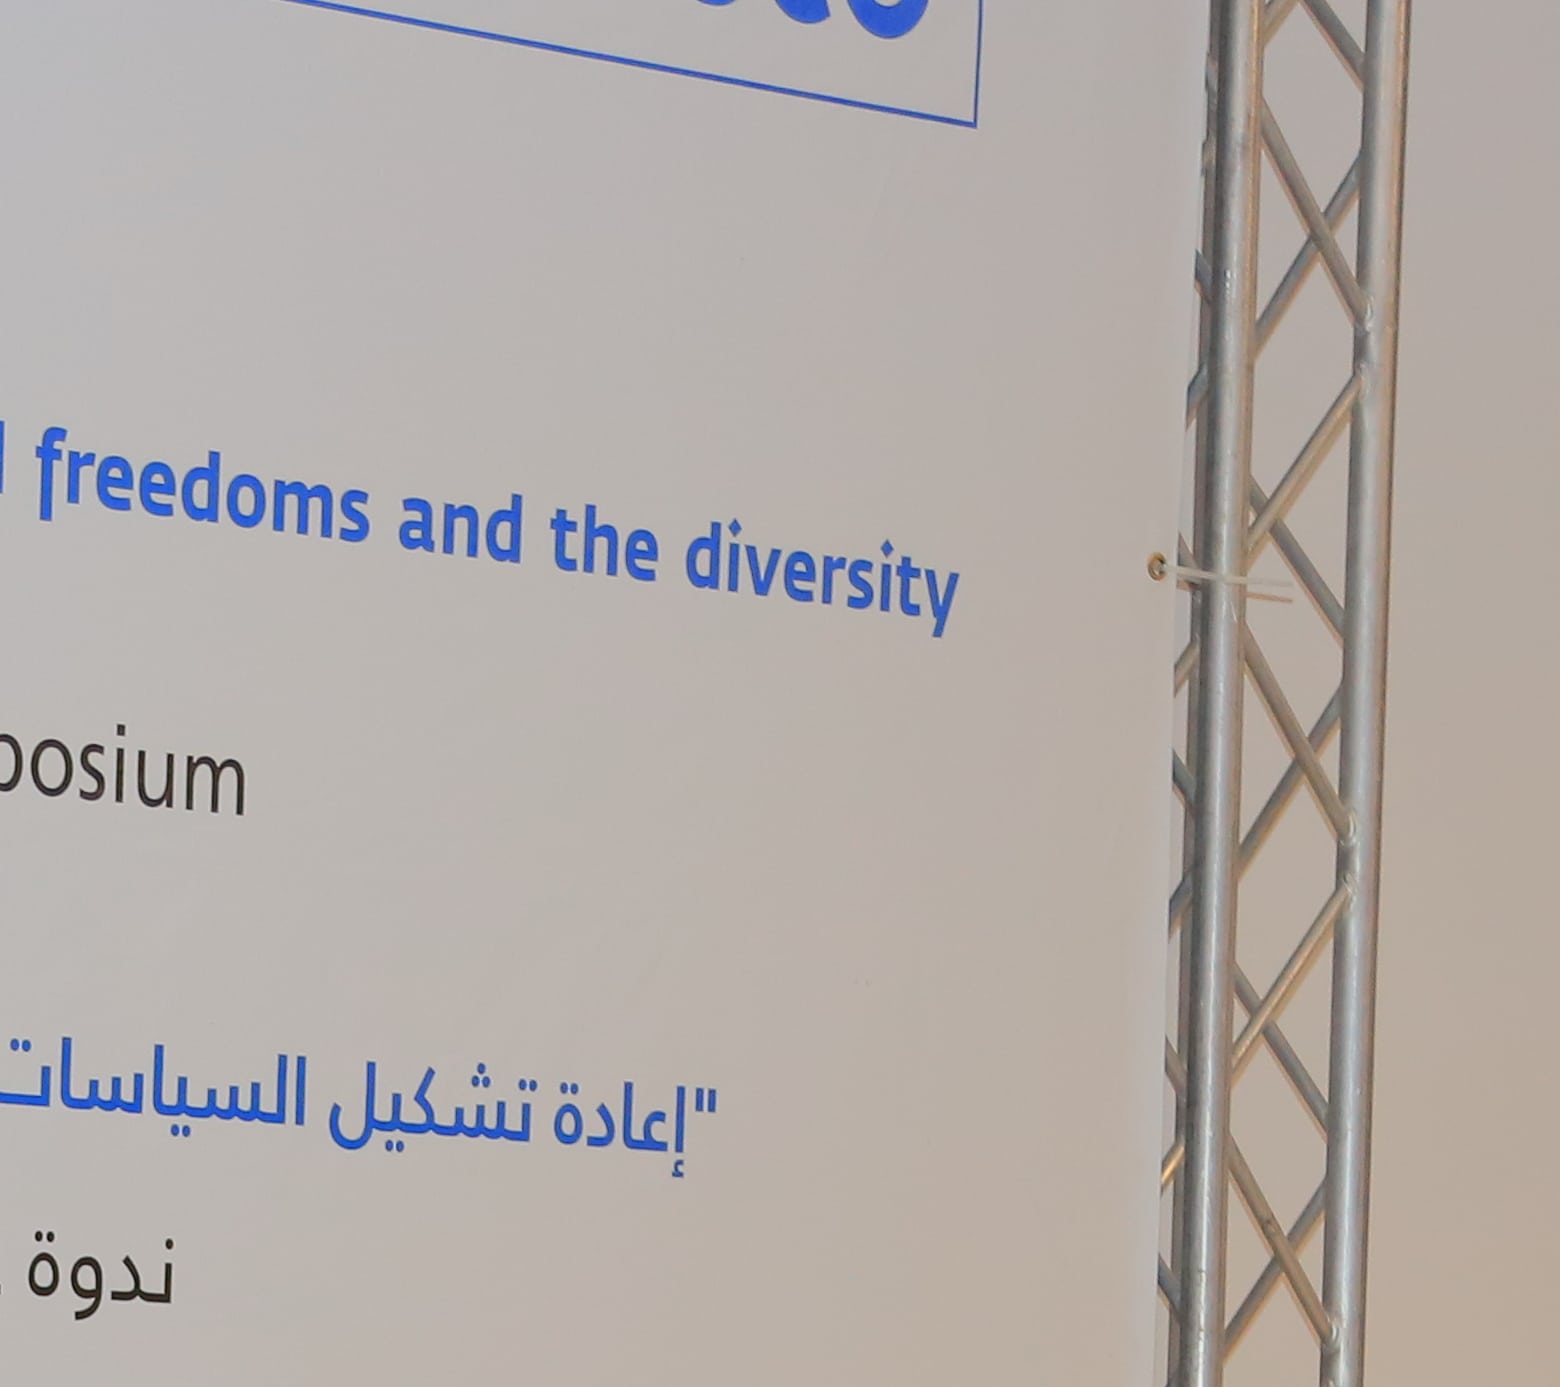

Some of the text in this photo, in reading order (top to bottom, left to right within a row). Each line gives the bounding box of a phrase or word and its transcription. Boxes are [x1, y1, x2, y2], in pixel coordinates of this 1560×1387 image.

[35, 426, 370, 543] freedoms
[399, 493, 523, 563] and
[550, 503, 659, 582] the
[686, 519, 959, 637] diversity
[329, 1061, 538, 1152] تشكيل
[554, 1082, 717, 1177] "إعادة
[28, 1230, 173, 1321] ندوة
